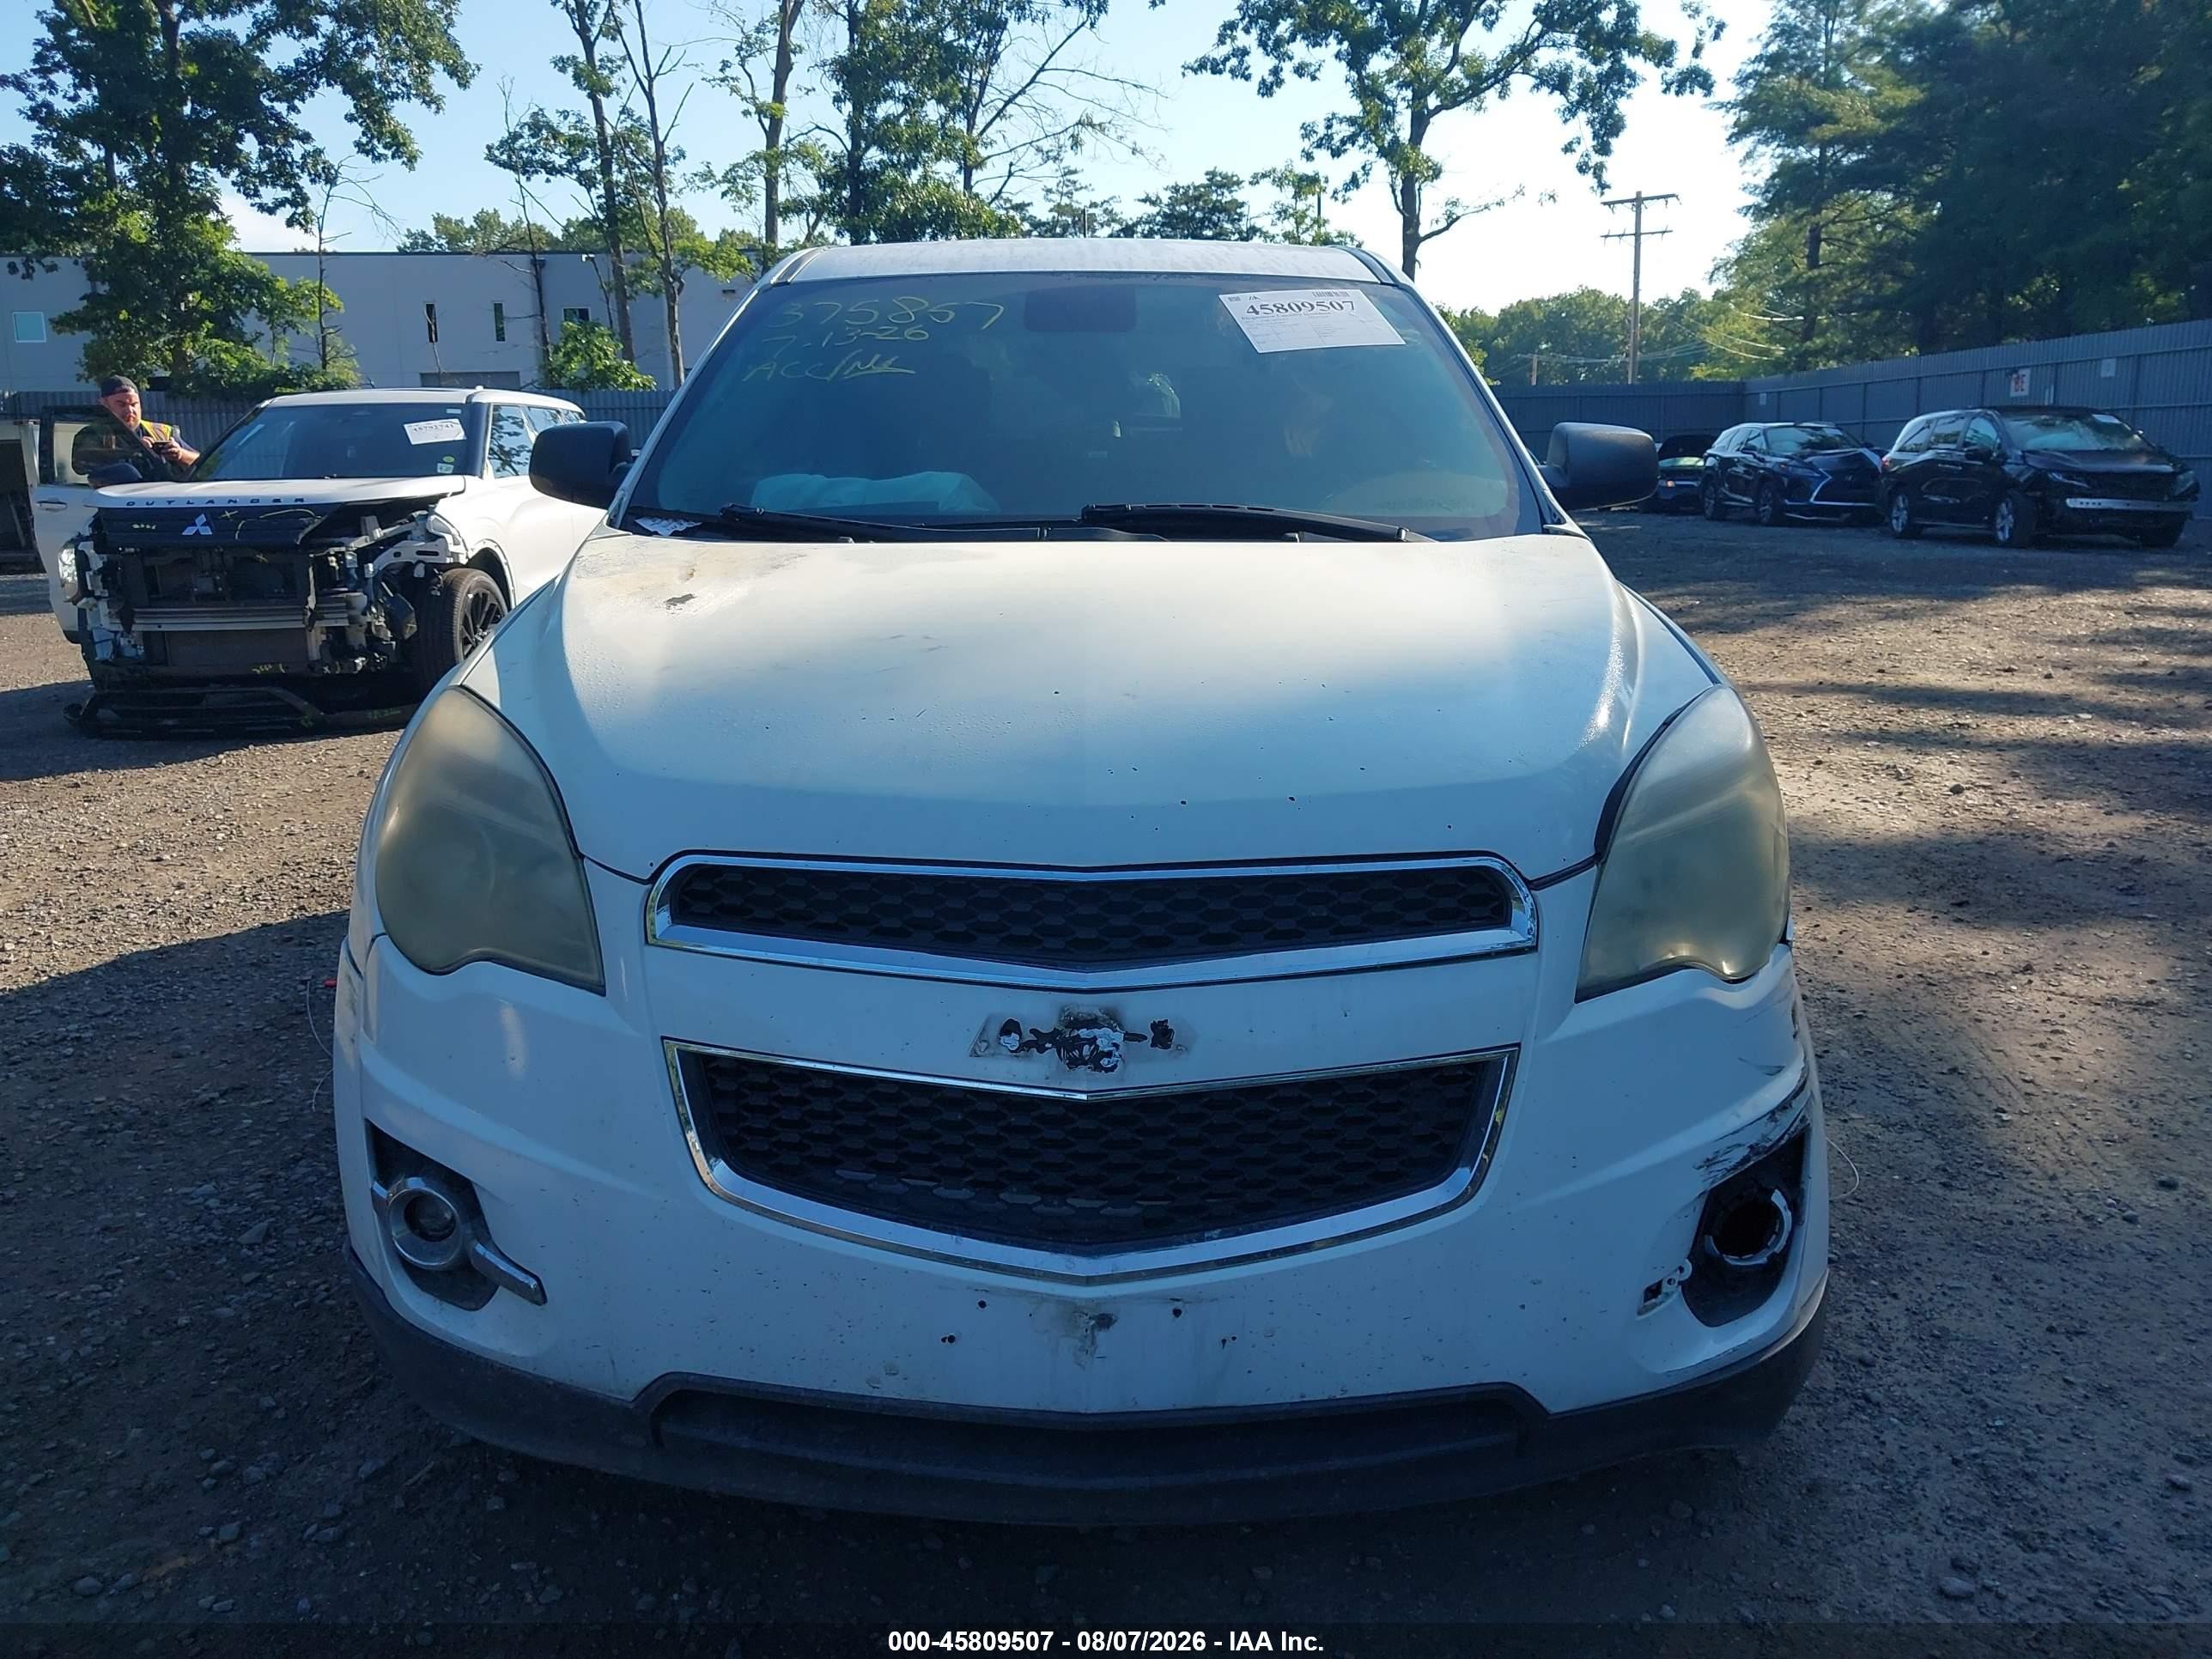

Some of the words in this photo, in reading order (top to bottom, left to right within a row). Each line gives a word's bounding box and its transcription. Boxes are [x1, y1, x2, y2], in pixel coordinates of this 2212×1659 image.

[766, 295, 1006, 331] 375857
[1246, 301, 1355, 315] 45809507
[125, 497, 305, 507] OUTLANDER
